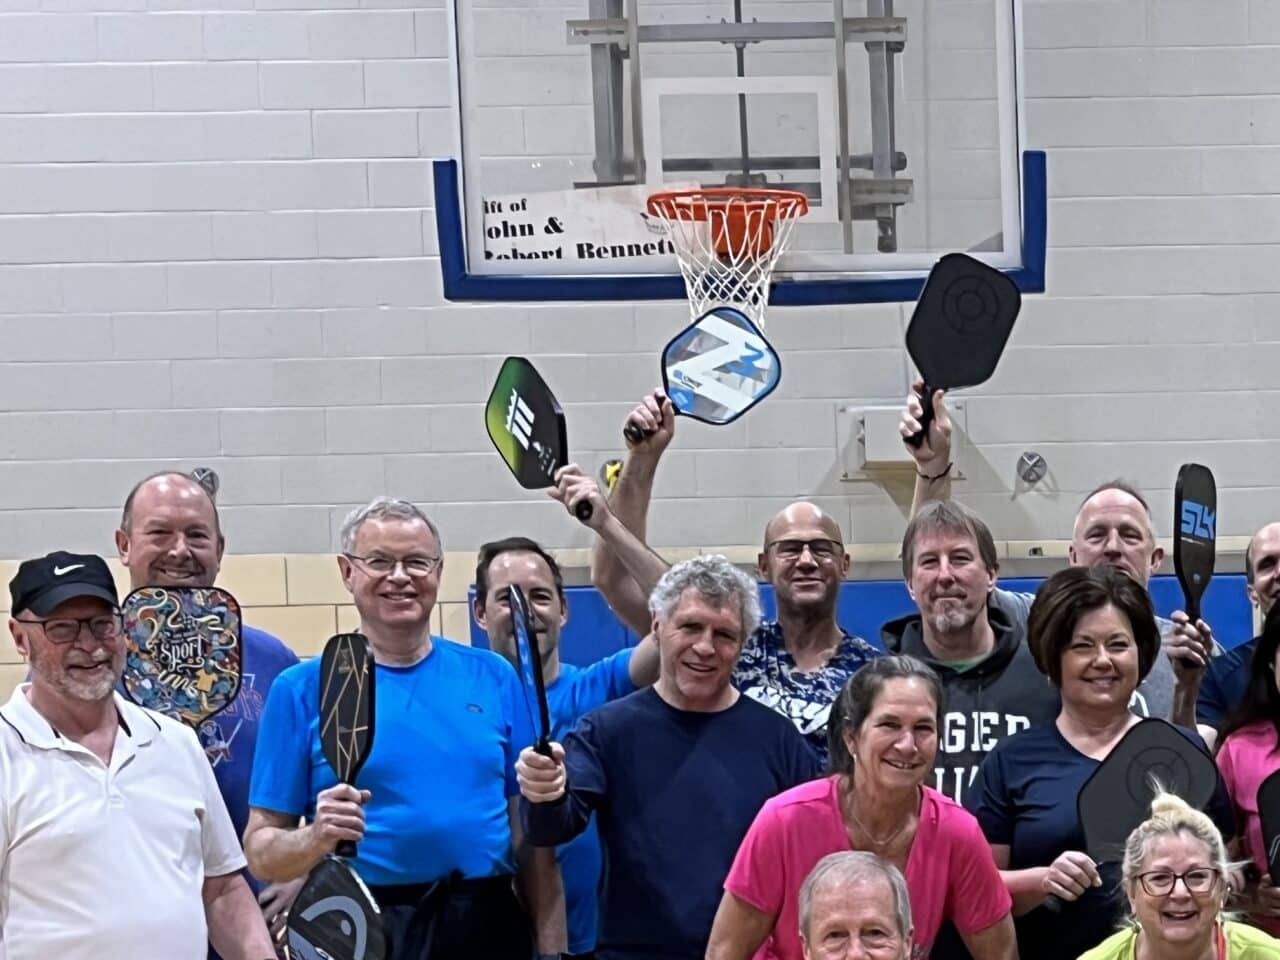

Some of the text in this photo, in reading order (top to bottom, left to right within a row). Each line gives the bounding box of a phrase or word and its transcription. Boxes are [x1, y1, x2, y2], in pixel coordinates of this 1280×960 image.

[484, 198, 527, 214] ift of
[487, 216, 565, 239] ohn &
